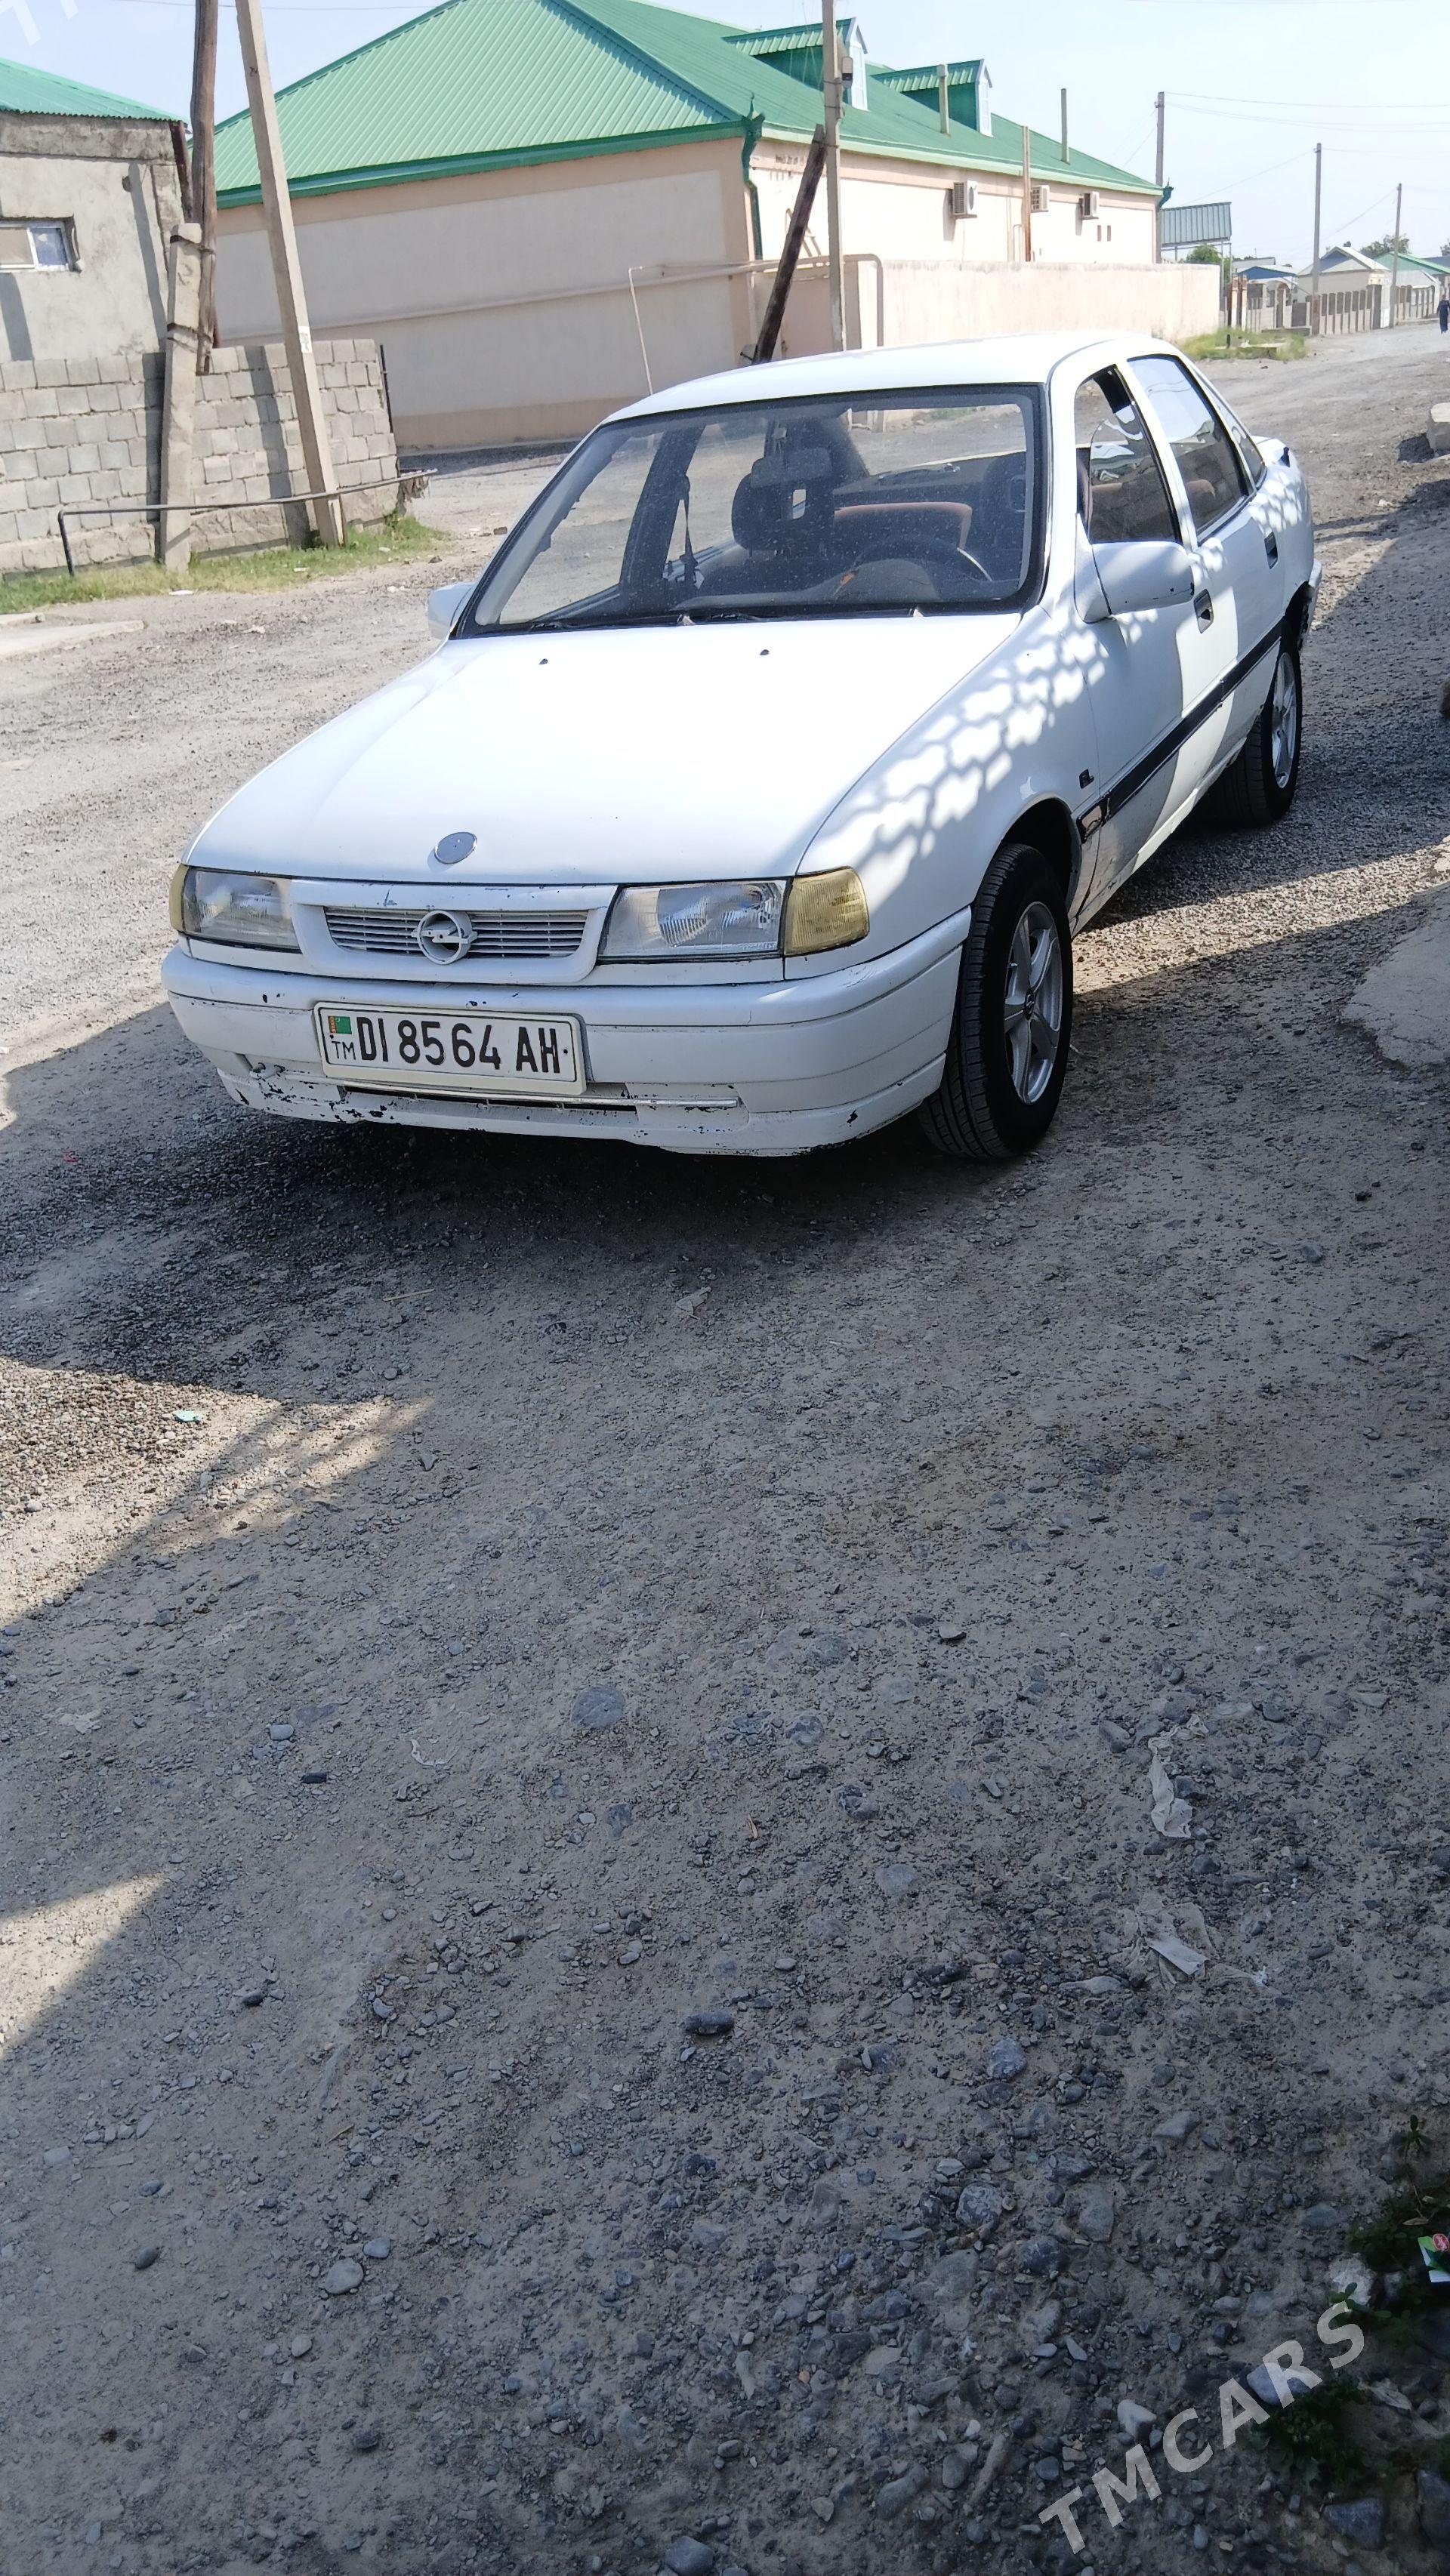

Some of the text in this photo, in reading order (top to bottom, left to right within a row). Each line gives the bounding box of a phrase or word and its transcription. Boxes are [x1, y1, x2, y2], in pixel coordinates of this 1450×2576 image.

[331, 1040, 356, 1061] TM
[356, 1016, 560, 1074] DI 8564 AH
